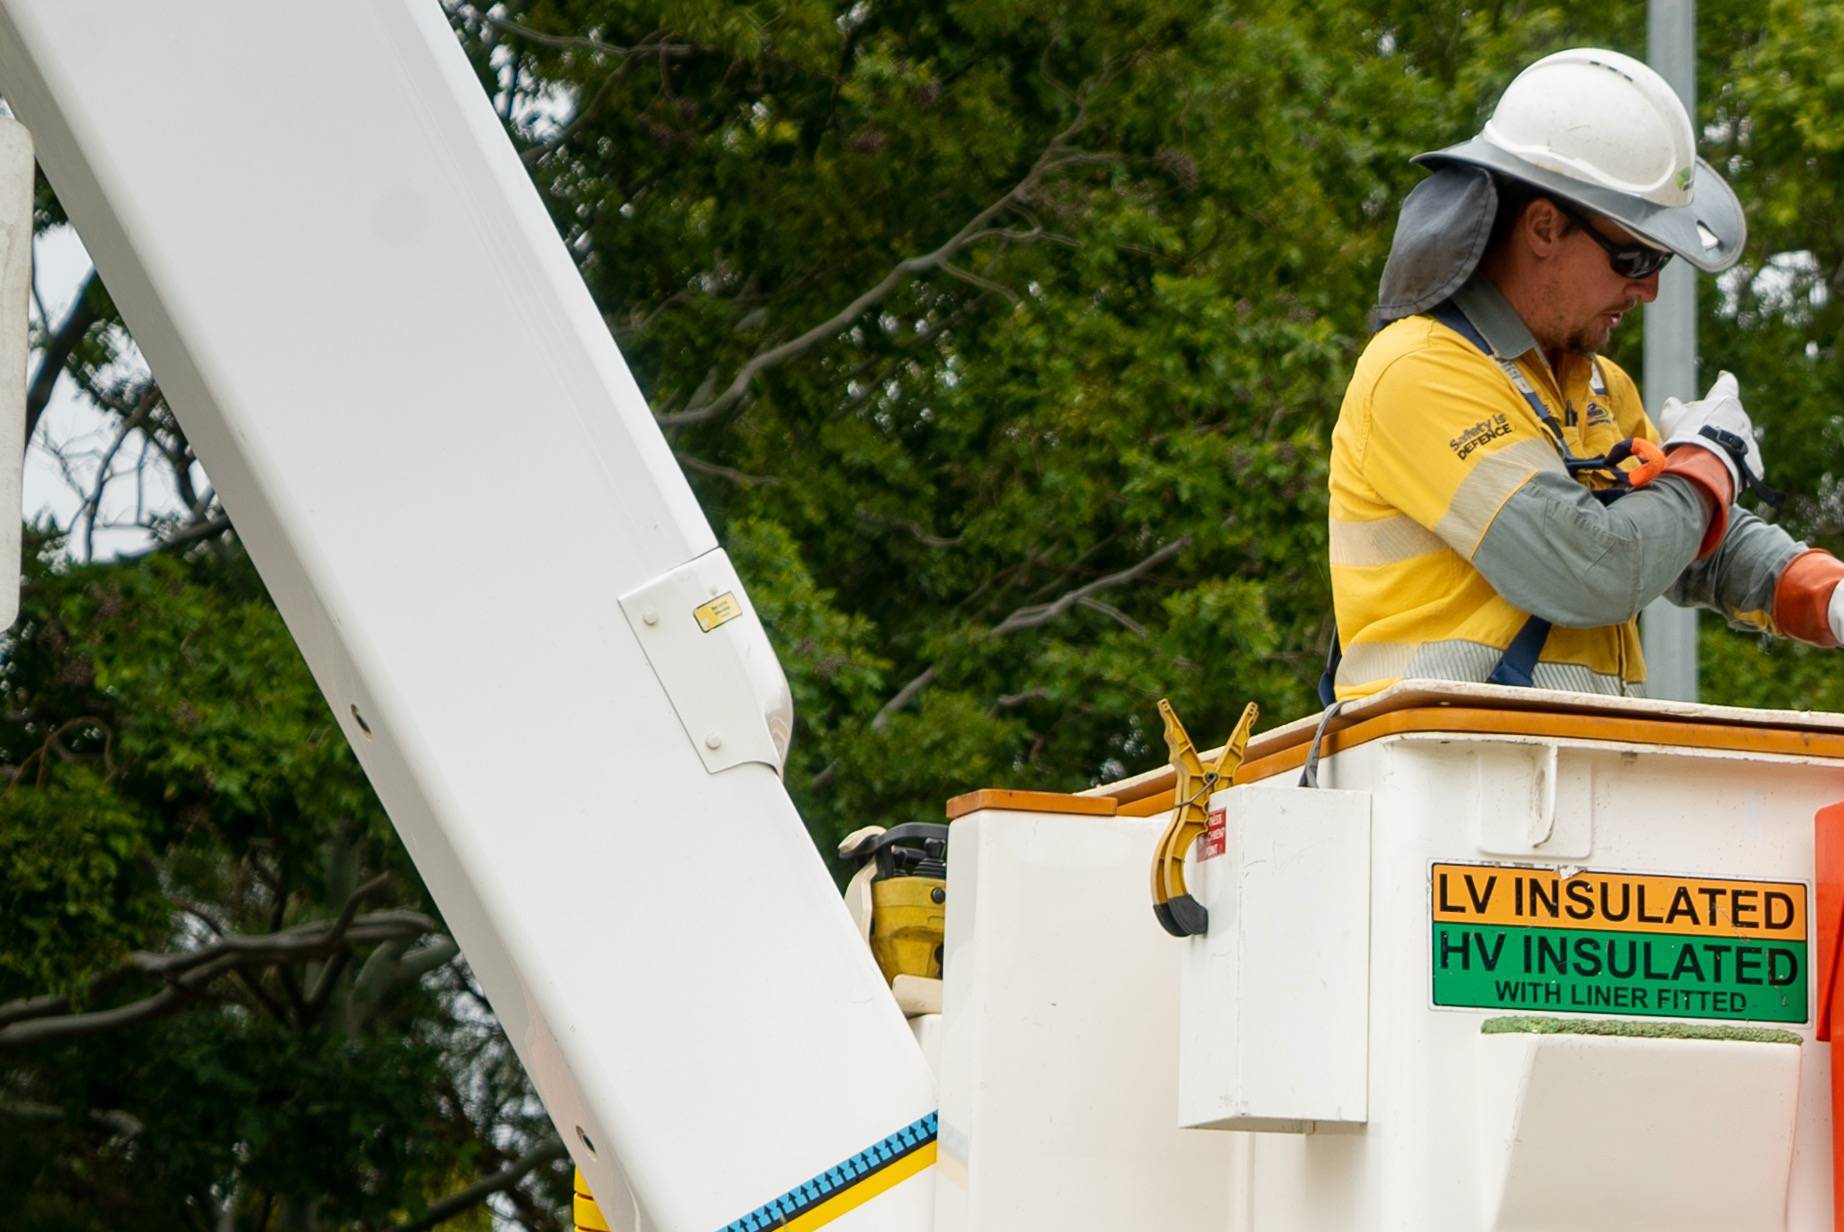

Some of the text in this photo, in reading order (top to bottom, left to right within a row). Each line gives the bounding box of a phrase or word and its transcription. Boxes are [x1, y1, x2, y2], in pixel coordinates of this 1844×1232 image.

[1457, 423, 1513, 461] DEFENCE
[1439, 873, 1795, 930] LV INSULATED
[1440, 930, 1799, 987] HV INSULATED
[1495, 980, 1747, 1013] WITH LINER FITTED
